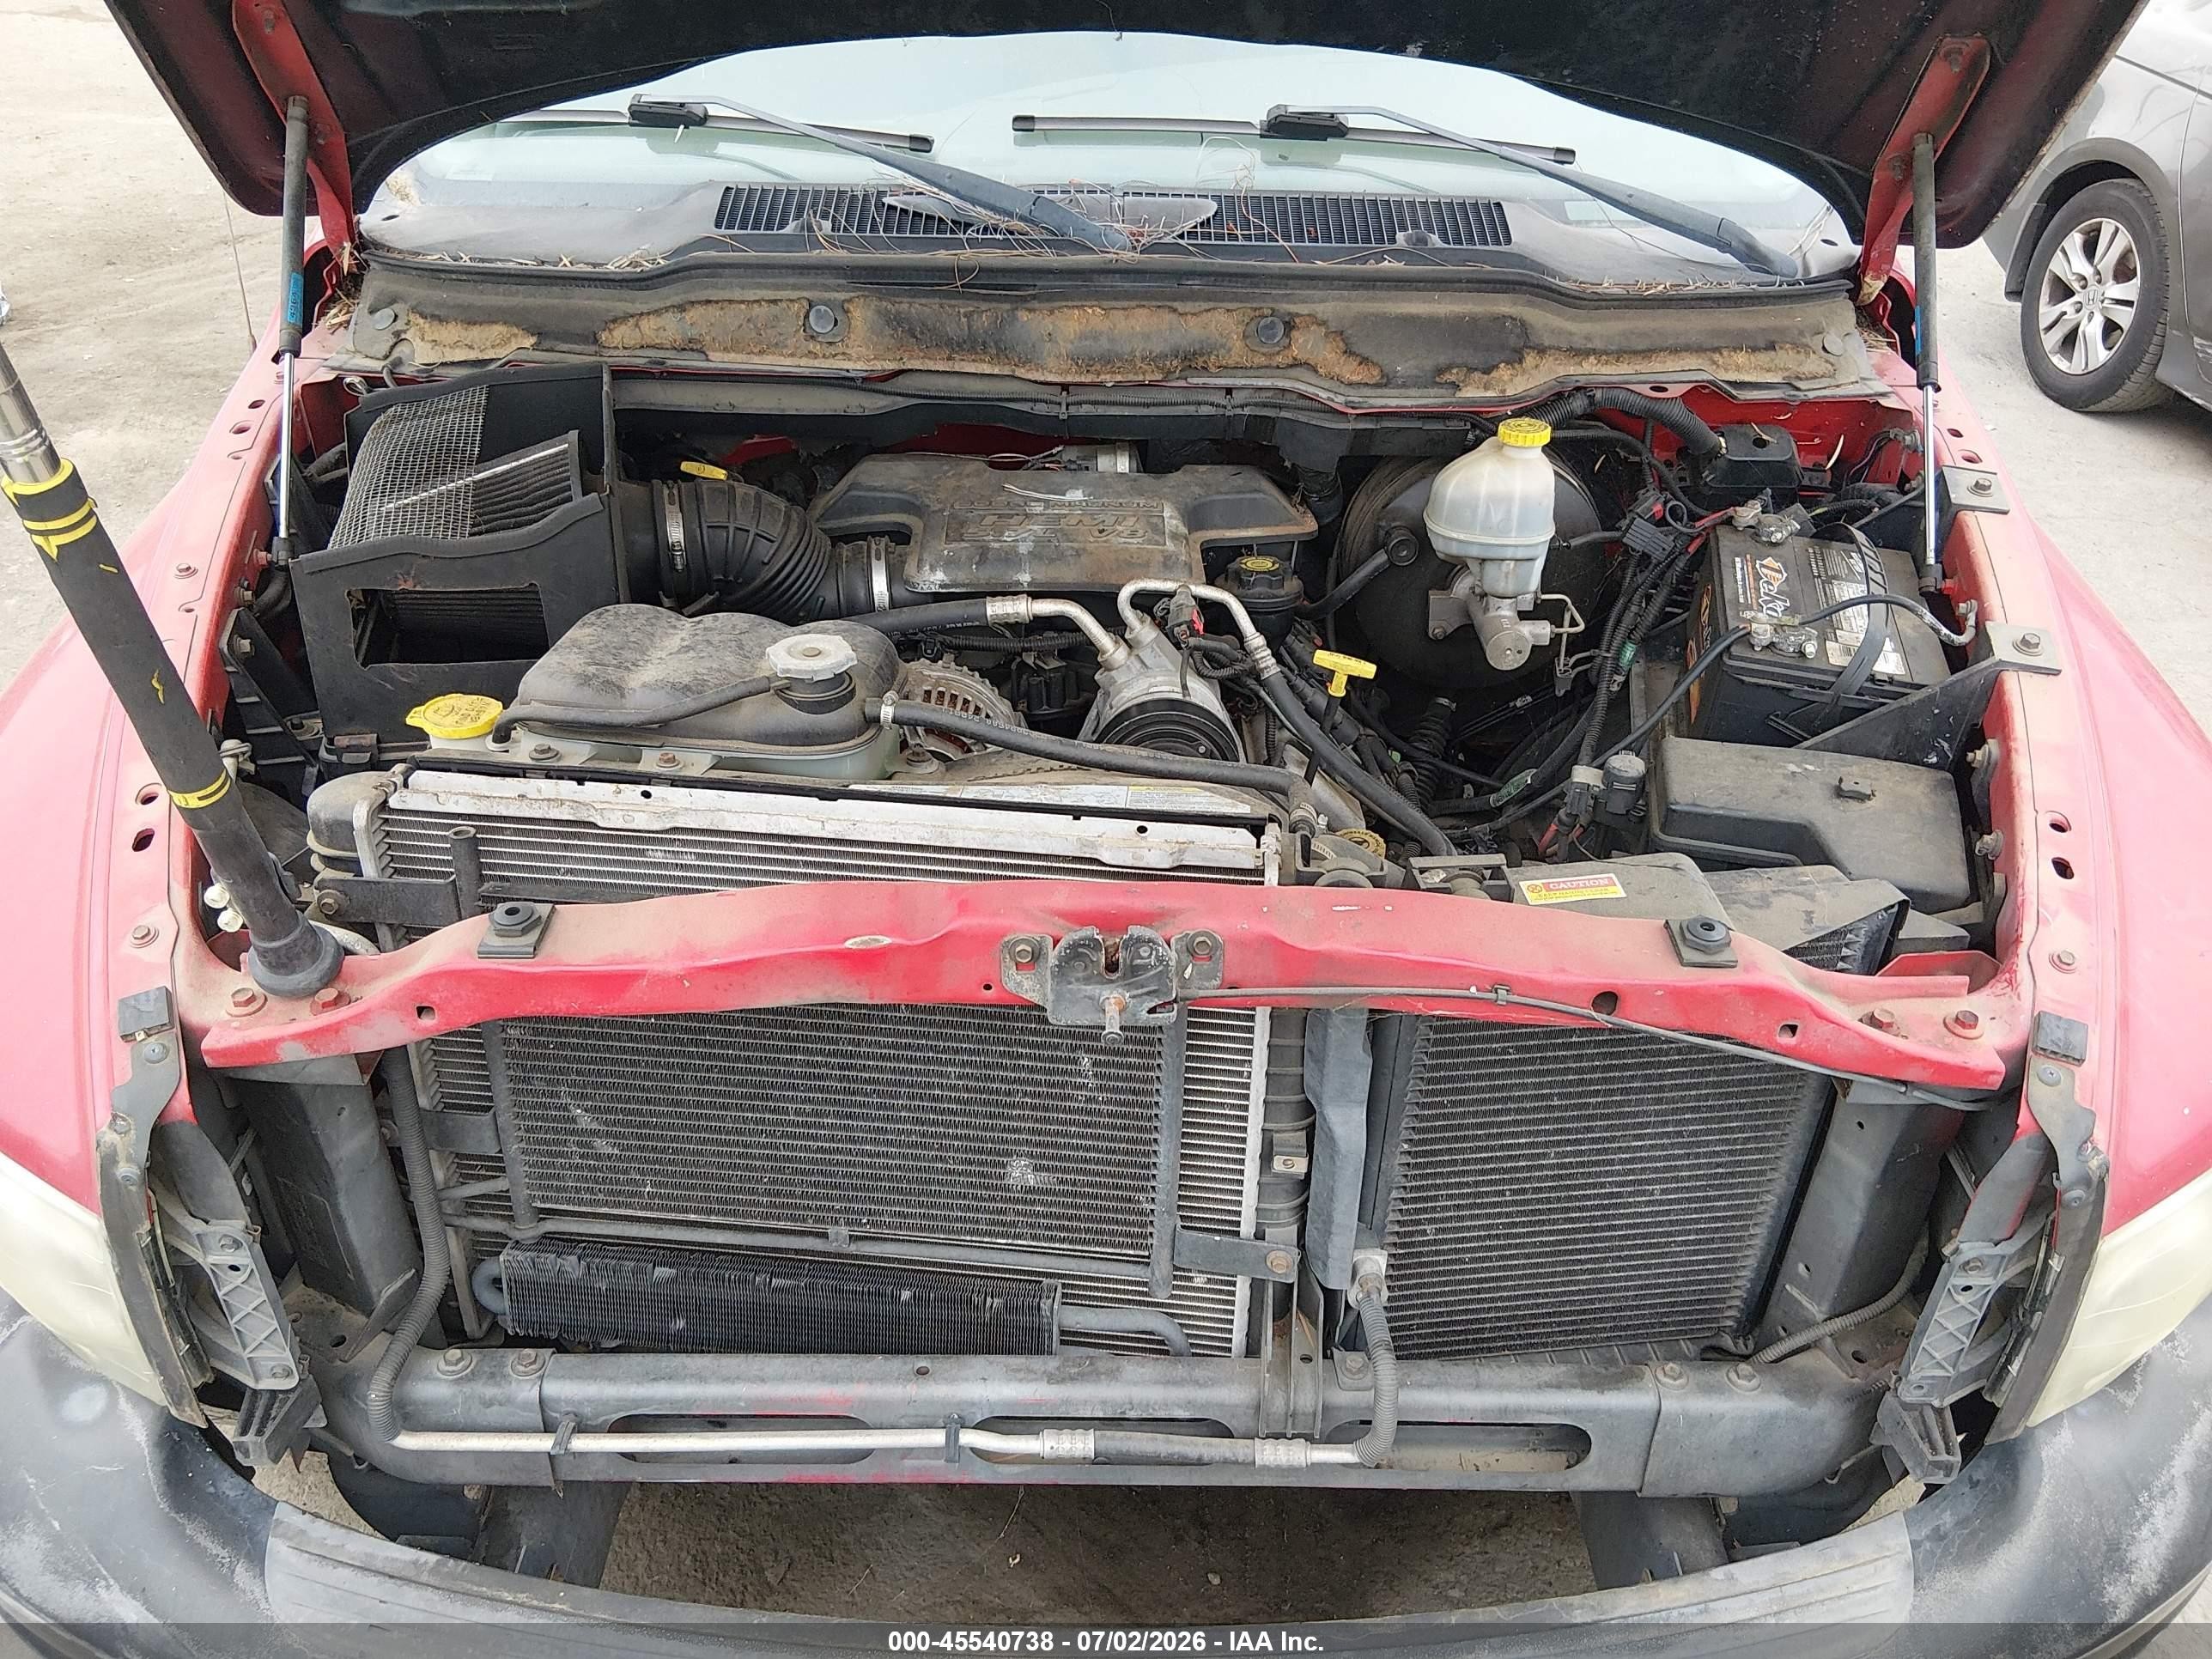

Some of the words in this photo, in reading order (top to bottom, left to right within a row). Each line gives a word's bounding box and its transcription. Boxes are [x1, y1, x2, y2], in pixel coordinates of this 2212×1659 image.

[979, 514, 1140, 527] HEMI
[1089, 527, 1149, 540] V8
[1549, 878, 1609, 890] CAUTION
